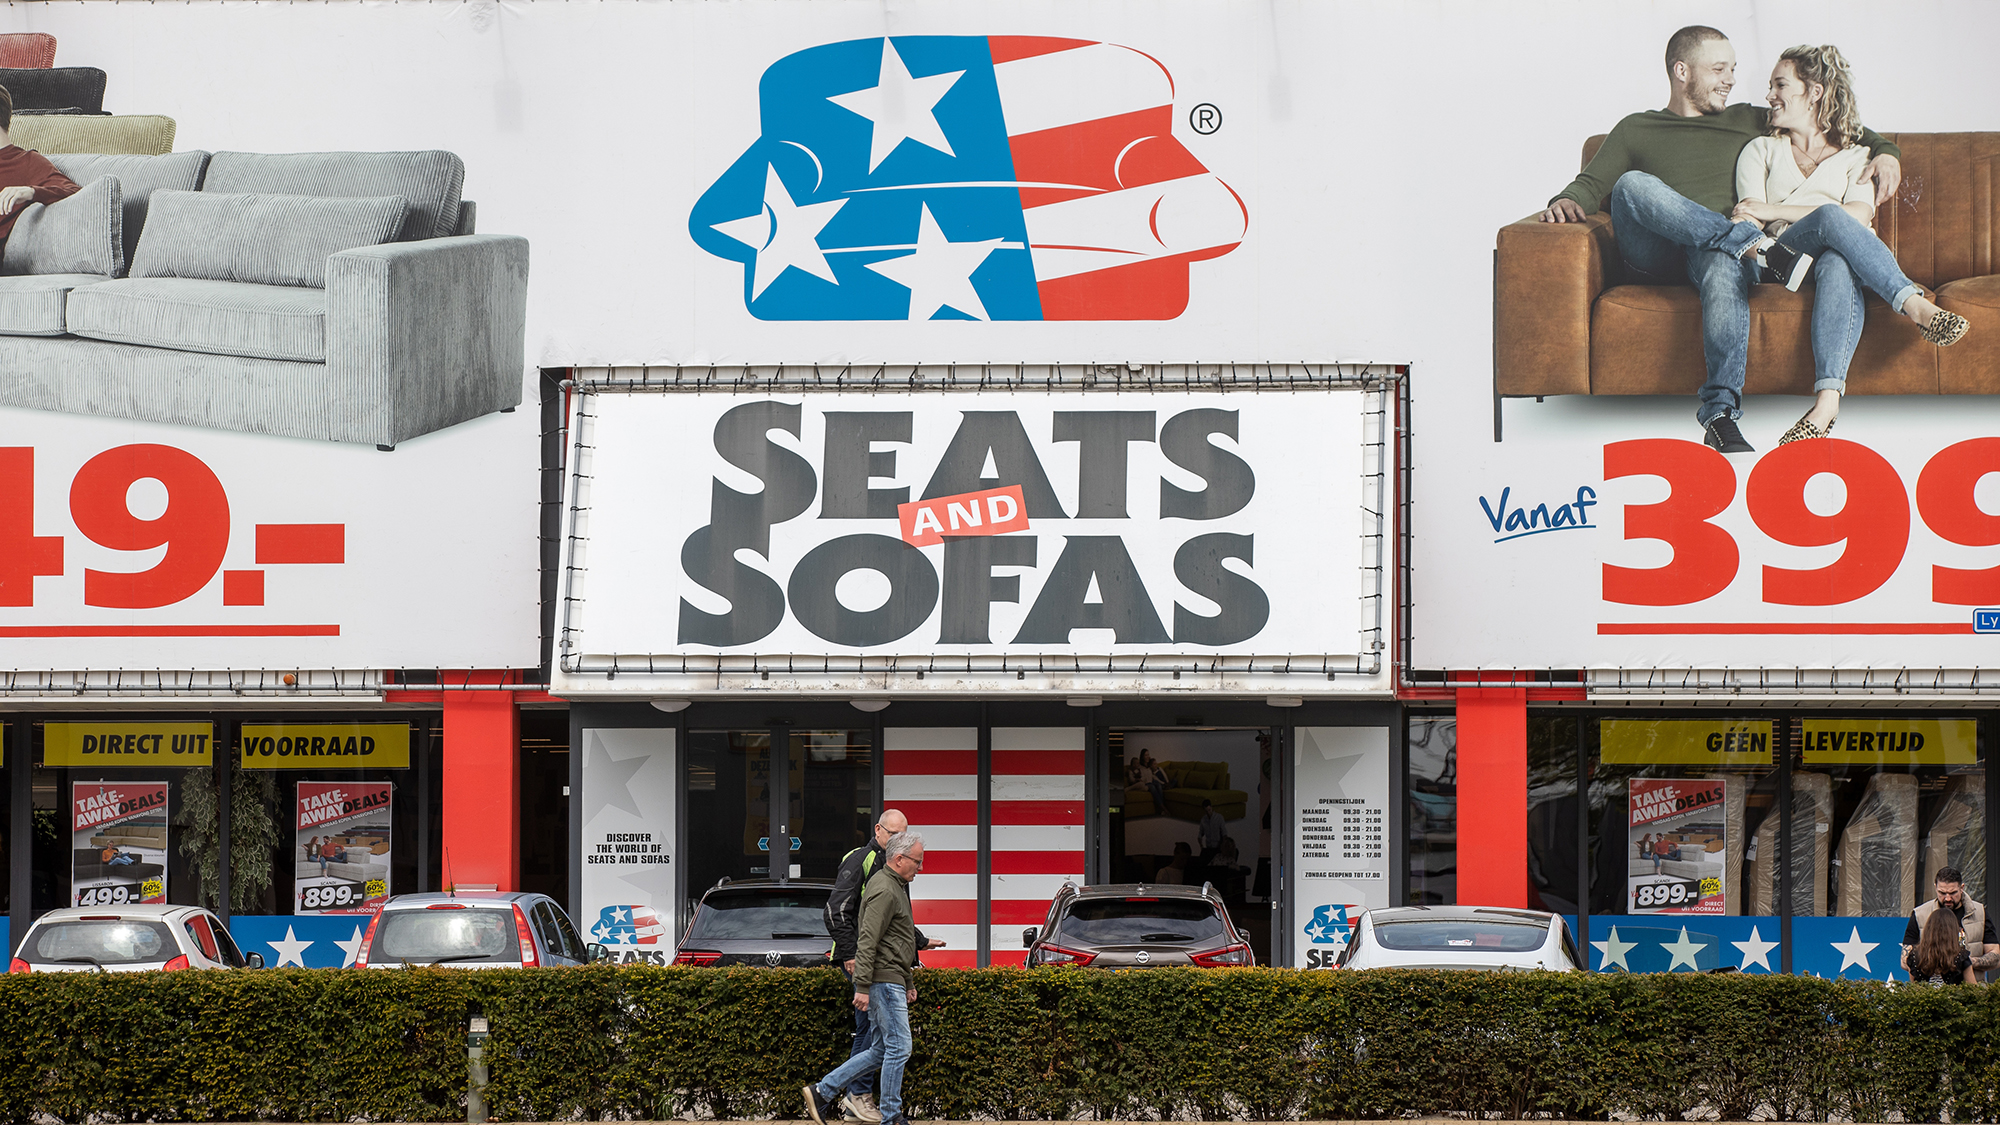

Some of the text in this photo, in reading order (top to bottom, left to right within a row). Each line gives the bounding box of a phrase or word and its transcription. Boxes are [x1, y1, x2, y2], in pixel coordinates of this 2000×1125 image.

[711, 400, 1257, 525] SEATS
[911, 494, 1019, 537] AND
[1478, 485, 1598, 533] Vanaf
[677, 524, 1271, 647] SOFAS
[81, 734, 209, 754] DIRECT UIT
[243, 736, 376, 757] VOORRAAD
[1706, 726, 1767, 753] GÉÉN
[1804, 731, 1925, 752] LEVERTIJD
[76, 790, 124, 813] TAKE-
[300, 789, 348, 811] TAKE-
[1632, 786, 1681, 808] TAKE-
[606, 833, 651, 842] DISCOVER
[587, 854, 670, 864] SEATS AND SOFAS
[596, 844, 662, 853] THE WORLD OF
[143, 883, 160, 892] 60%
[304, 885, 363, 908] 899.-
[366, 883, 384, 892] 60%
[1637, 884, 1698, 906] 899.-
[1701, 882, 1719, 890] 60%
[604, 950, 666, 967] EATS
